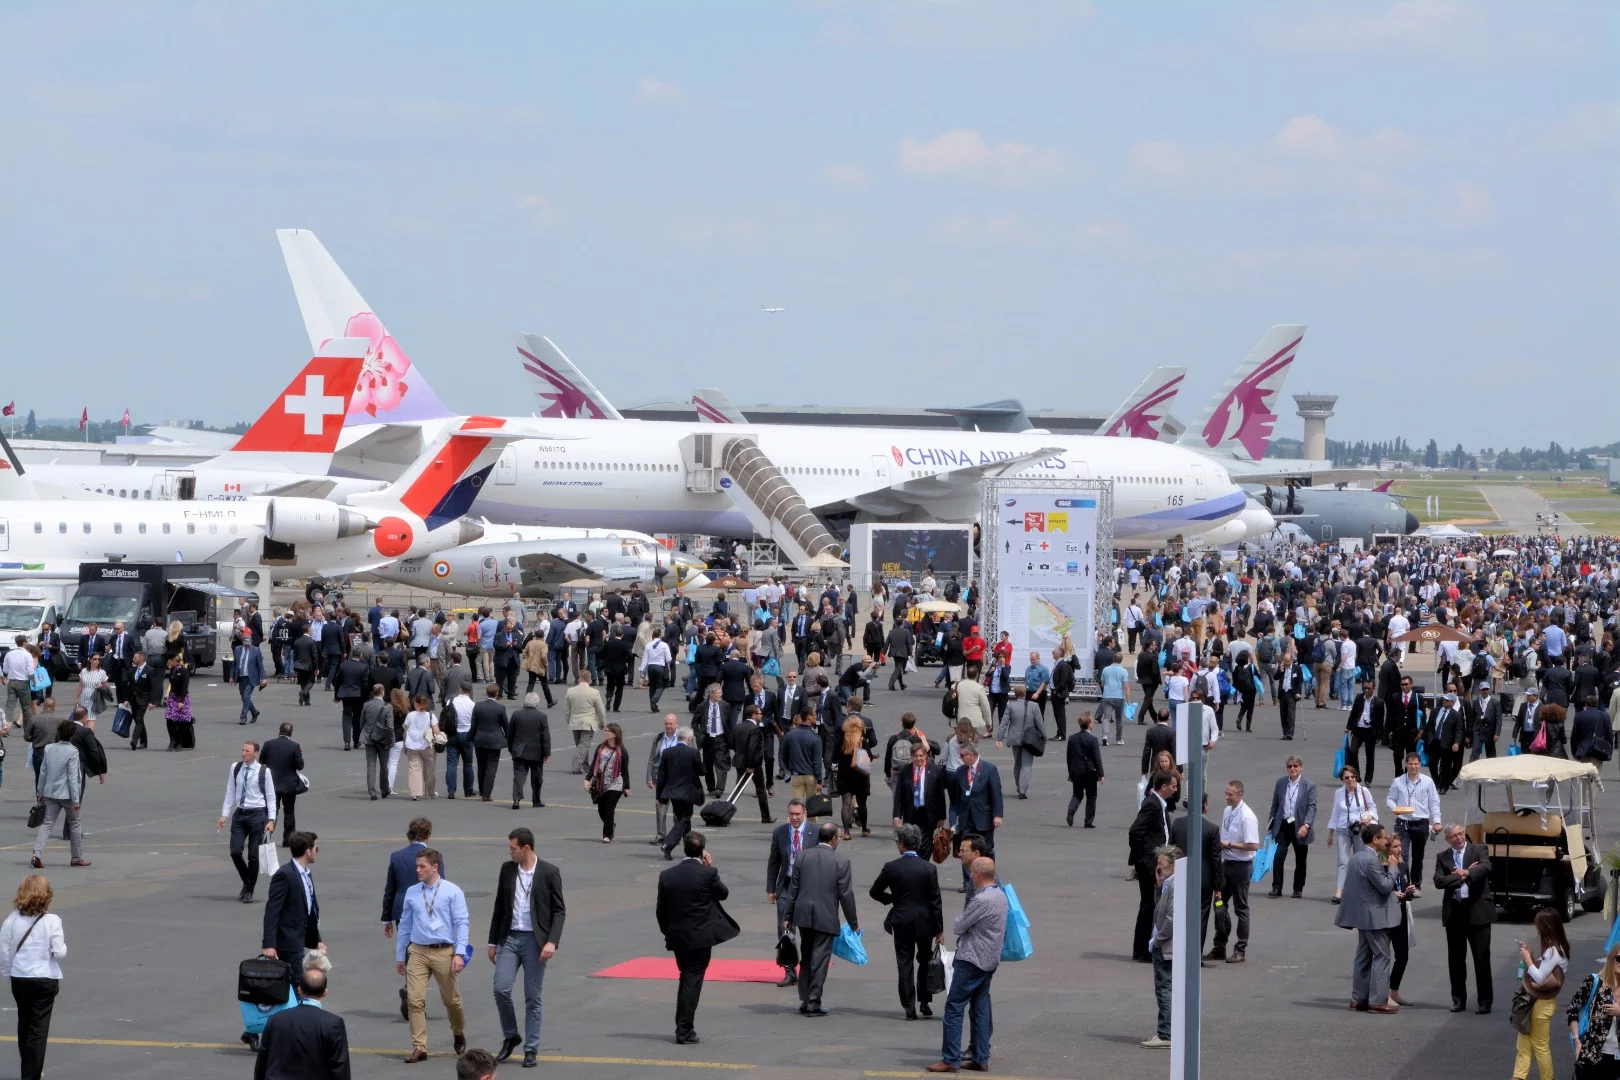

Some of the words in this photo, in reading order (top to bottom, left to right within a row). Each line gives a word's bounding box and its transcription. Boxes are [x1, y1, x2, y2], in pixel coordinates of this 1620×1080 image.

[905, 448, 974, 466] CHINA
[1167, 495, 1184, 506] 165
[882, 562, 901, 571] NEW
